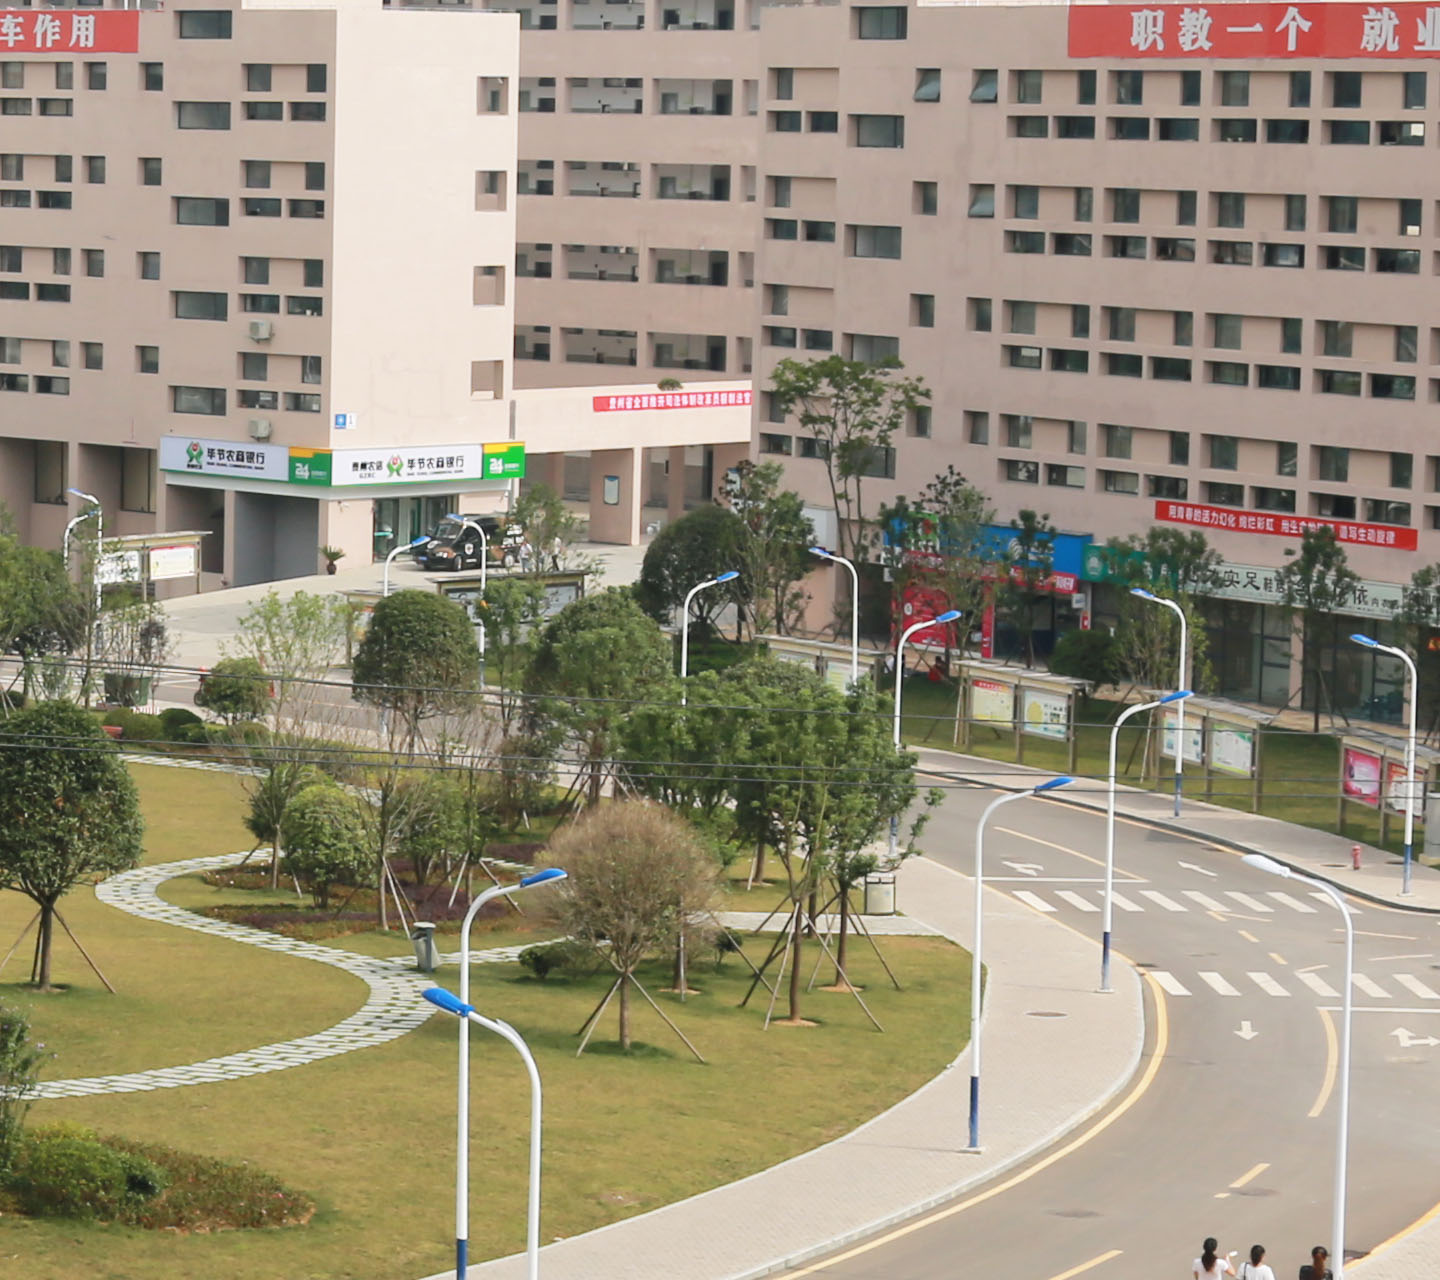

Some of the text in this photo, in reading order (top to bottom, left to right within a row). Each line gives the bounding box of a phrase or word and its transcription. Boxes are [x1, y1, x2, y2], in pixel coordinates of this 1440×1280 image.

[1130, 6, 1313, 52] 职教一个
[207, 447, 265, 465] 毕节农商银行
[407, 455, 465, 470] 毕节农商银行
